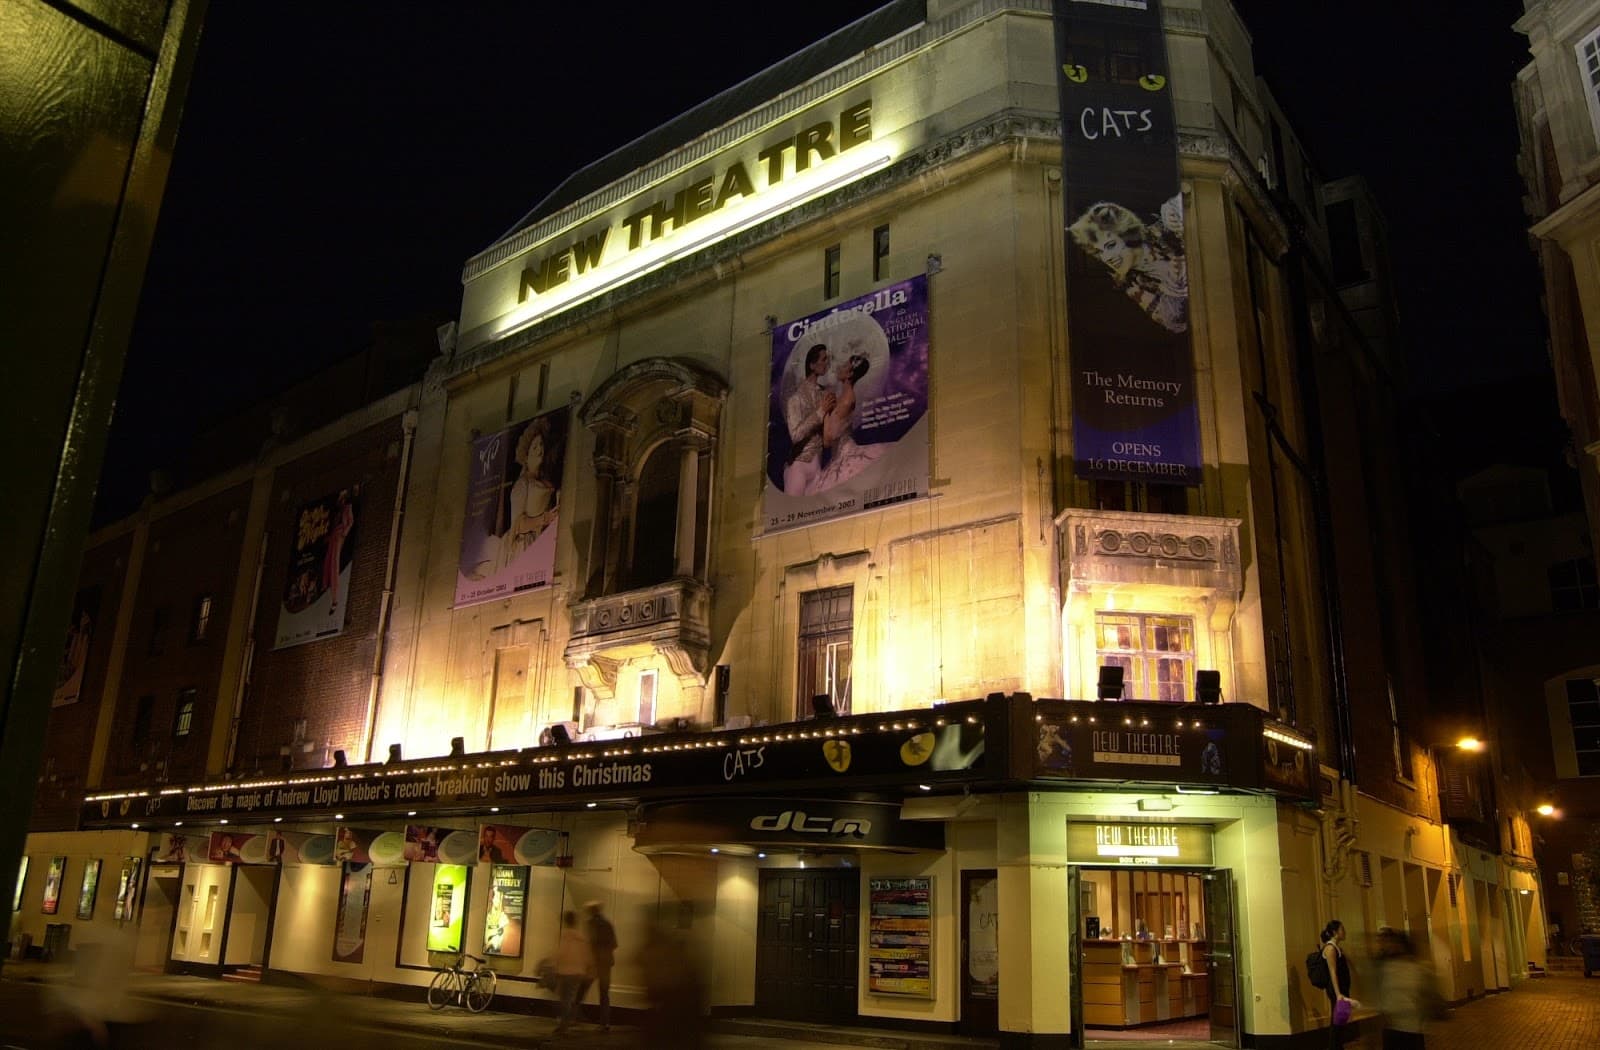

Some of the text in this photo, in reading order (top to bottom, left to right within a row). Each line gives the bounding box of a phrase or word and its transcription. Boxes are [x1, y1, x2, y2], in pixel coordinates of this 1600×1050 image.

[1080, 106, 1153, 140] CATS
[518, 100, 873, 304] NEW THEATRE
[787, 287, 908, 342] Cinderella
[884, 316, 926, 338] ATIONAL
[1083, 371, 1182, 396] The Memory
[1104, 389, 1164, 408] Returns
[1112, 442, 1162, 457] OPENS
[1088, 458, 1188, 476] 16 DECEMBER
[797, 506, 836, 519] November
[838, 499, 856, 511] 2003
[1092, 731, 1181, 755] NEW THEATRE
[724, 745, 766, 781] CATS
[187, 762, 652, 812] Discover the magic of Andrew Lloyd Webber's record-breaking show this Christmas
[1096, 825, 1178, 846] NEW THEATRE
[979, 912, 998, 929] CAT
